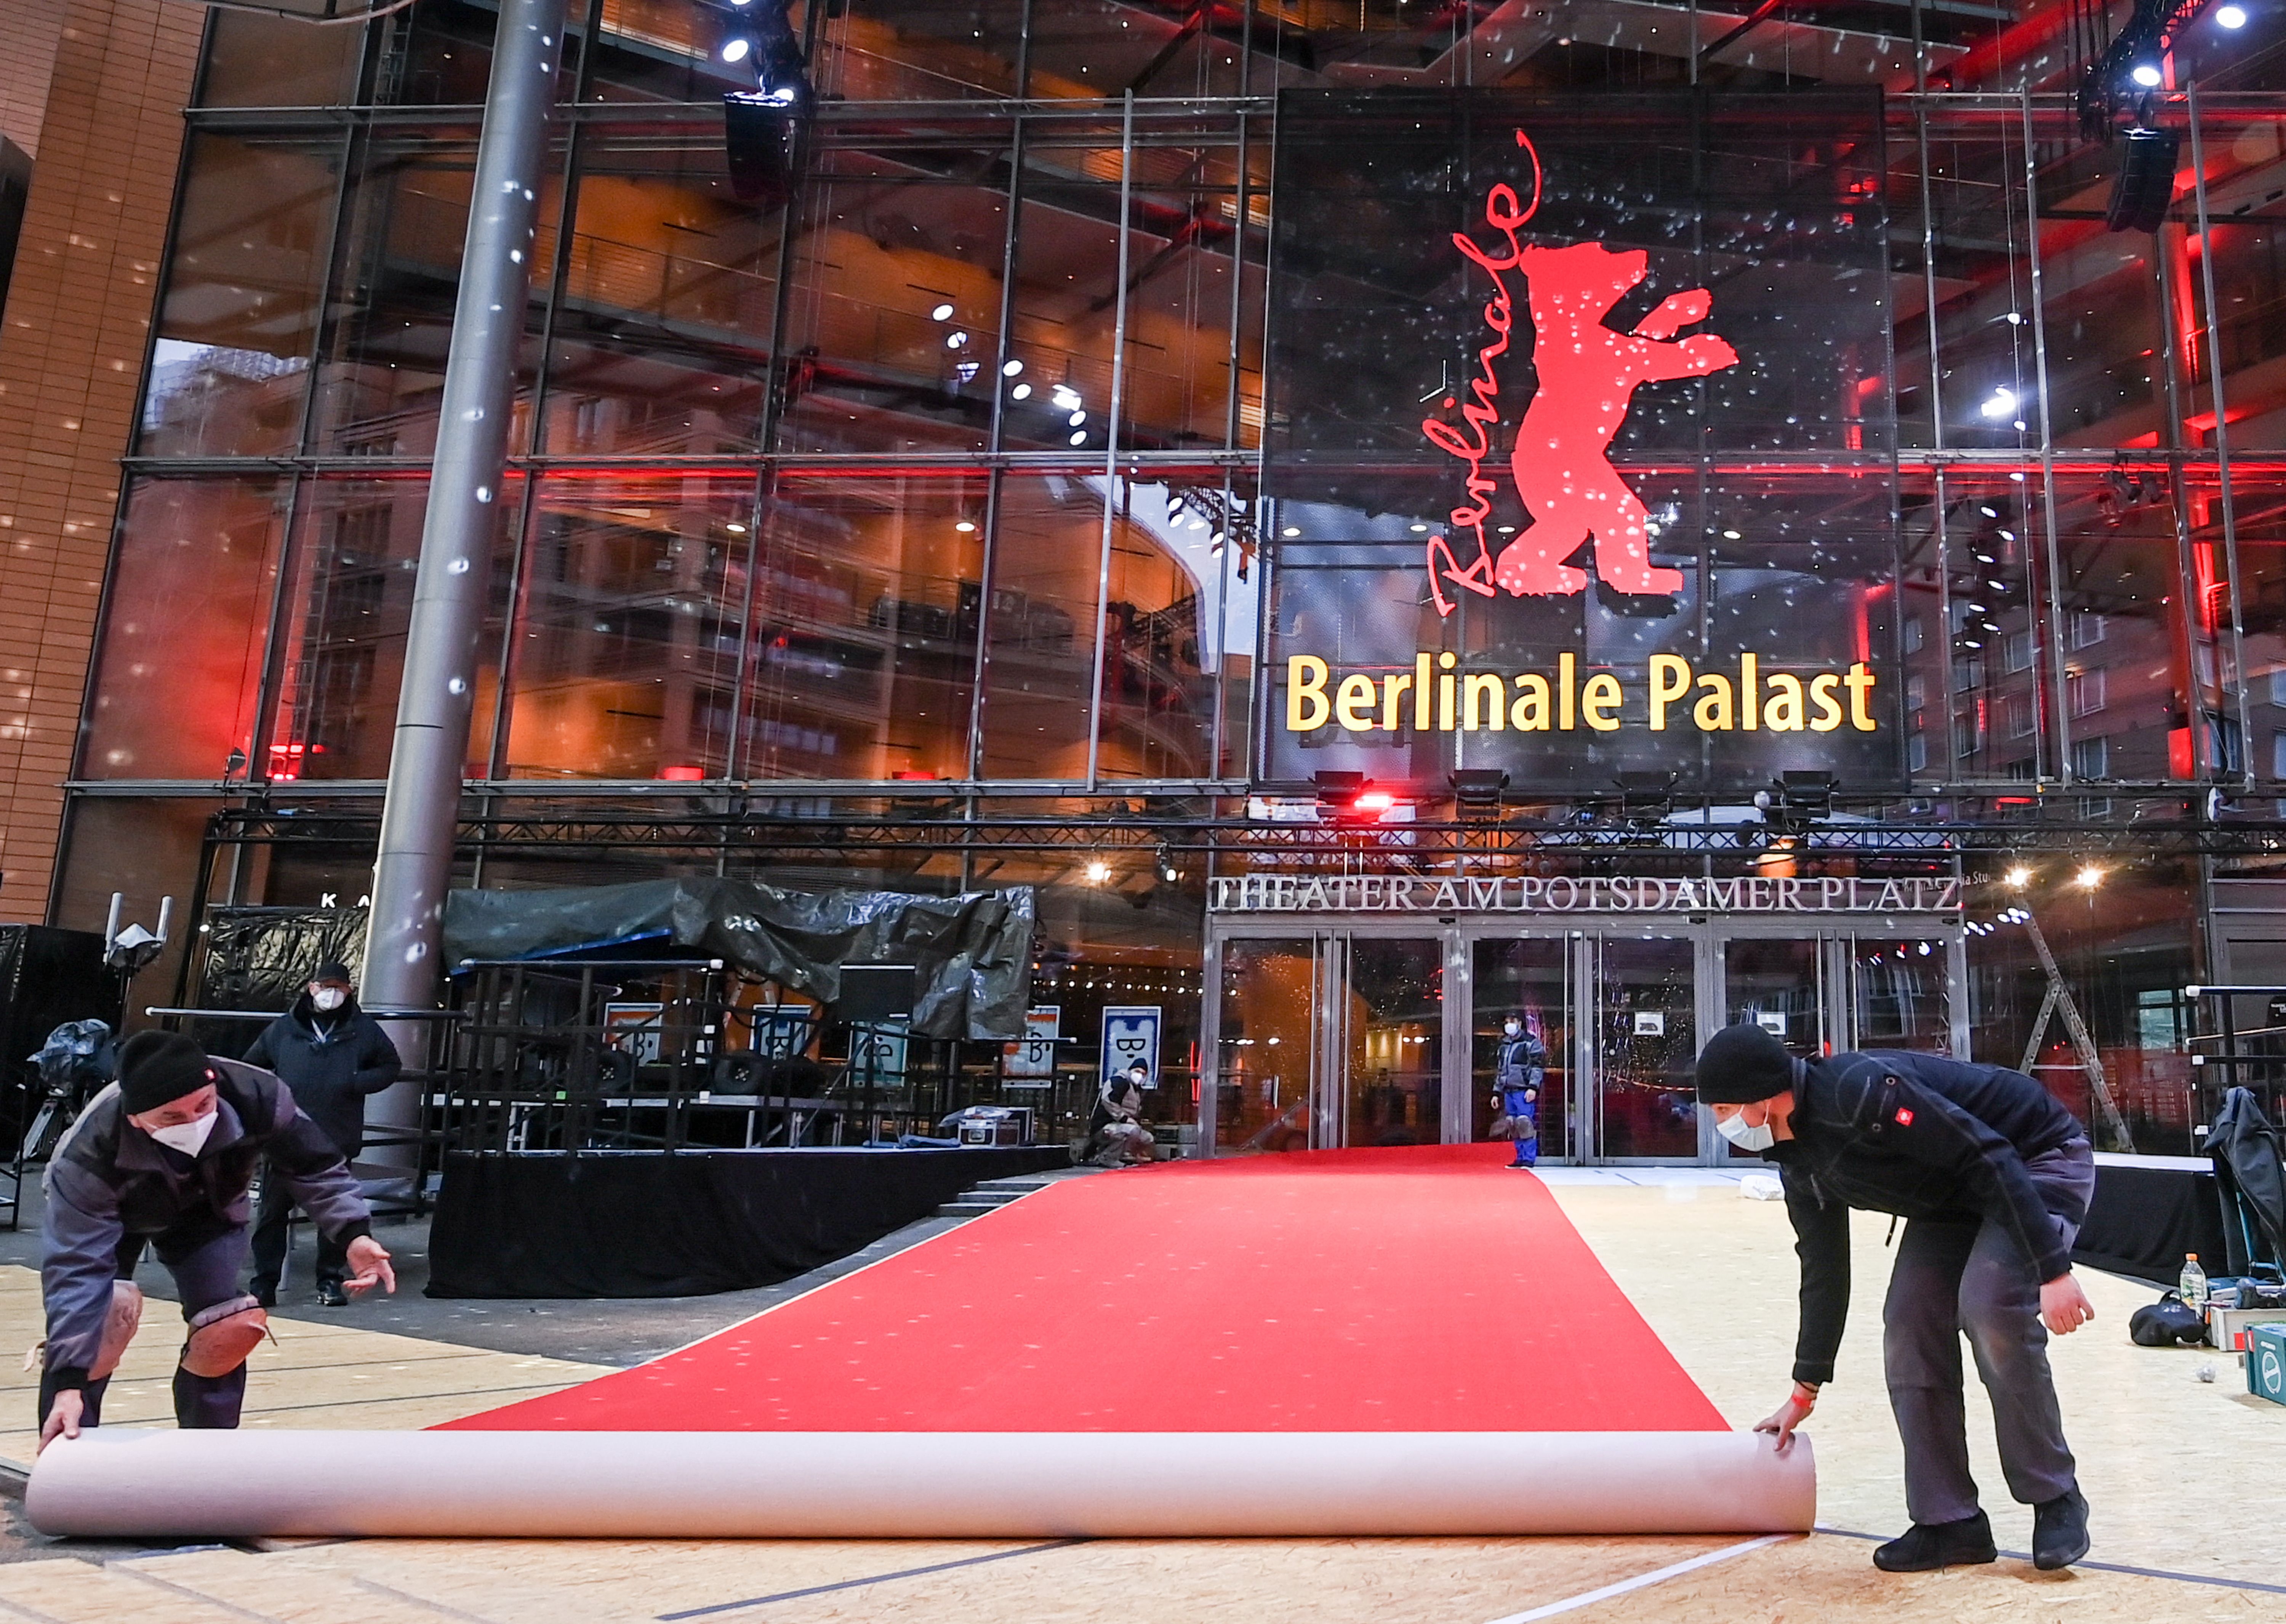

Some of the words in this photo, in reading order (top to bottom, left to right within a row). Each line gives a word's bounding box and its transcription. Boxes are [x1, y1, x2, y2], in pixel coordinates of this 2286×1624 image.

[1422, 129, 1542, 617] Berlinale
[1287, 652, 1622, 732] Berlinale
[1650, 652, 1876, 732] Palast
[1209, 876, 1418, 911] THEATER
[1430, 876, 1506, 910] AM
[1518, 876, 1807, 911] POTSDAMER
[1818, 876, 1962, 911] PLATZ
